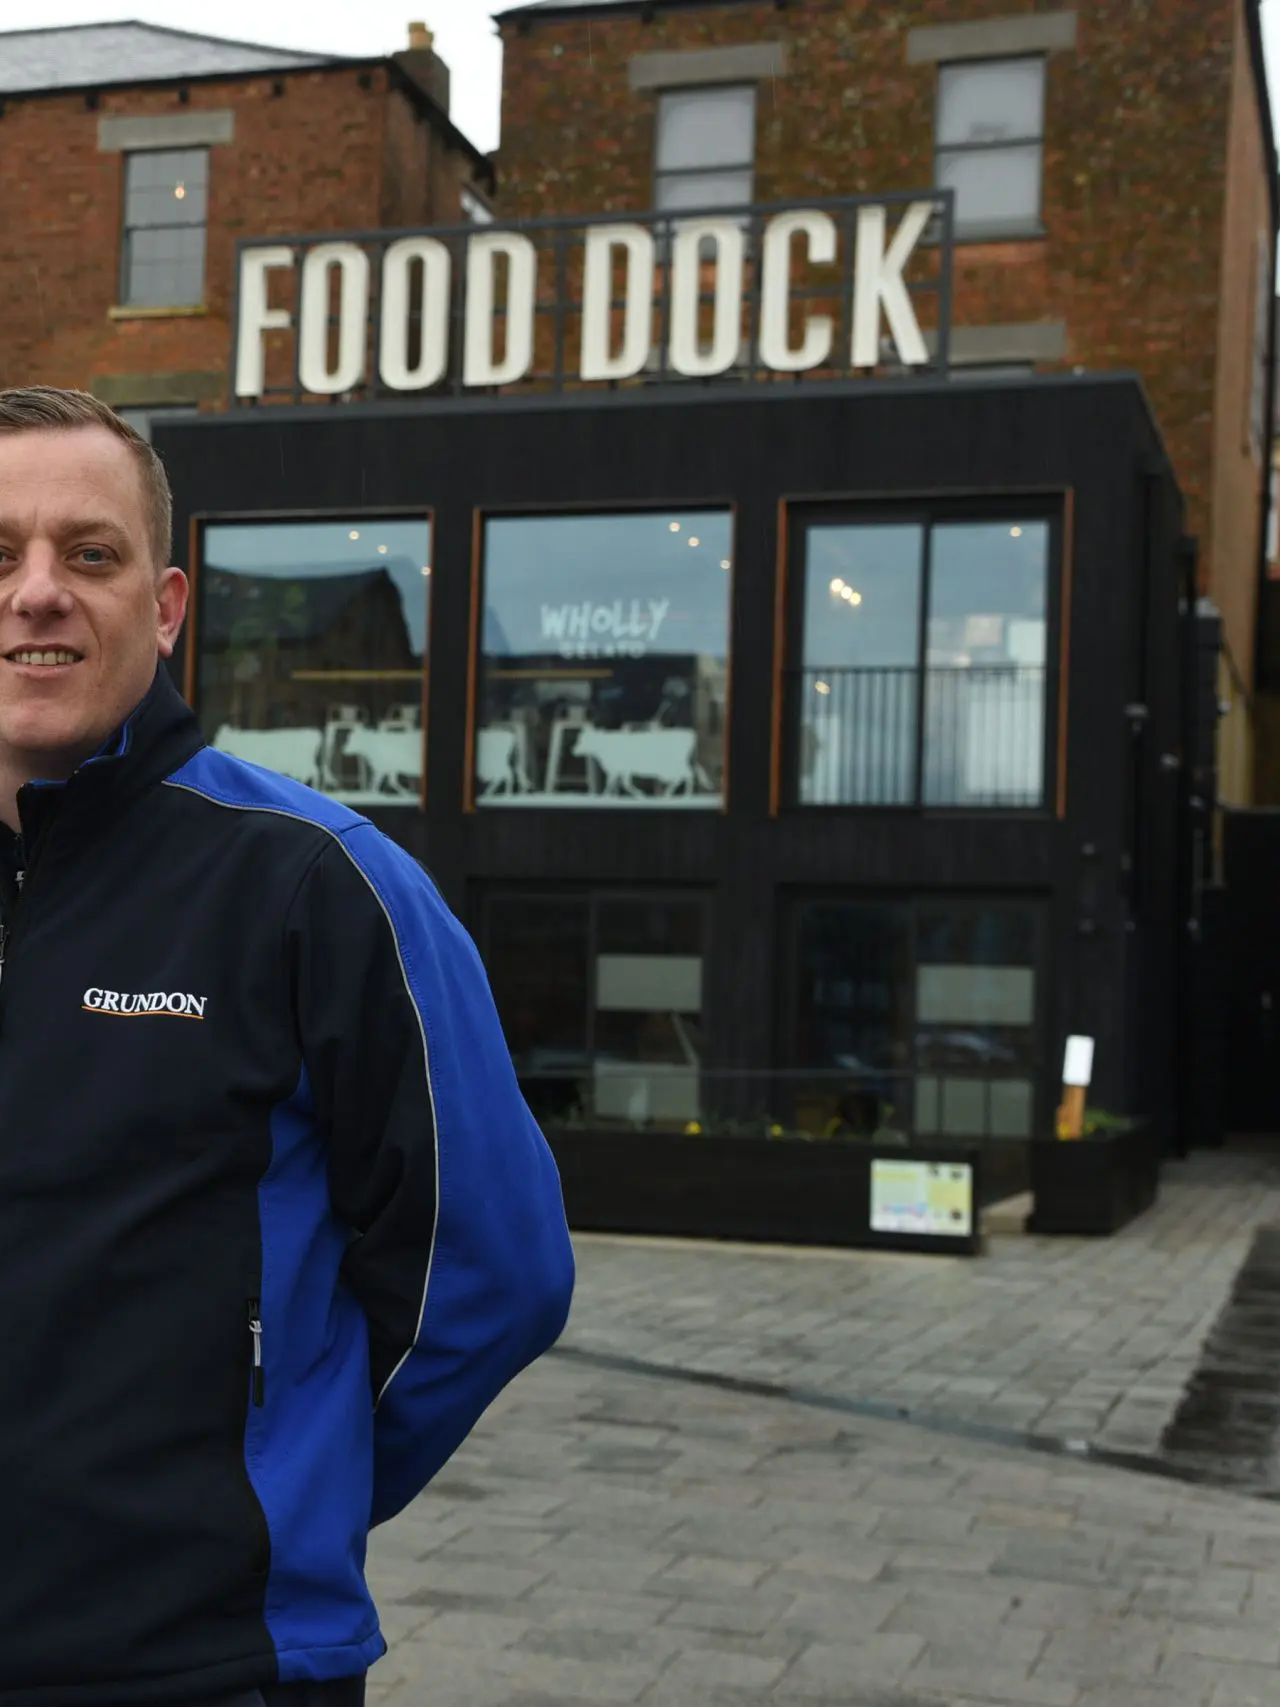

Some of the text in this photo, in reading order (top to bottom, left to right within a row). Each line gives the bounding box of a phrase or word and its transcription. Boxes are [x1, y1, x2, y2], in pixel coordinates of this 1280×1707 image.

[234, 202, 934, 397] FOOD DOCK
[539, 597, 670, 641] WHOLLY
[83, 988, 208, 1015] GRUNDON
